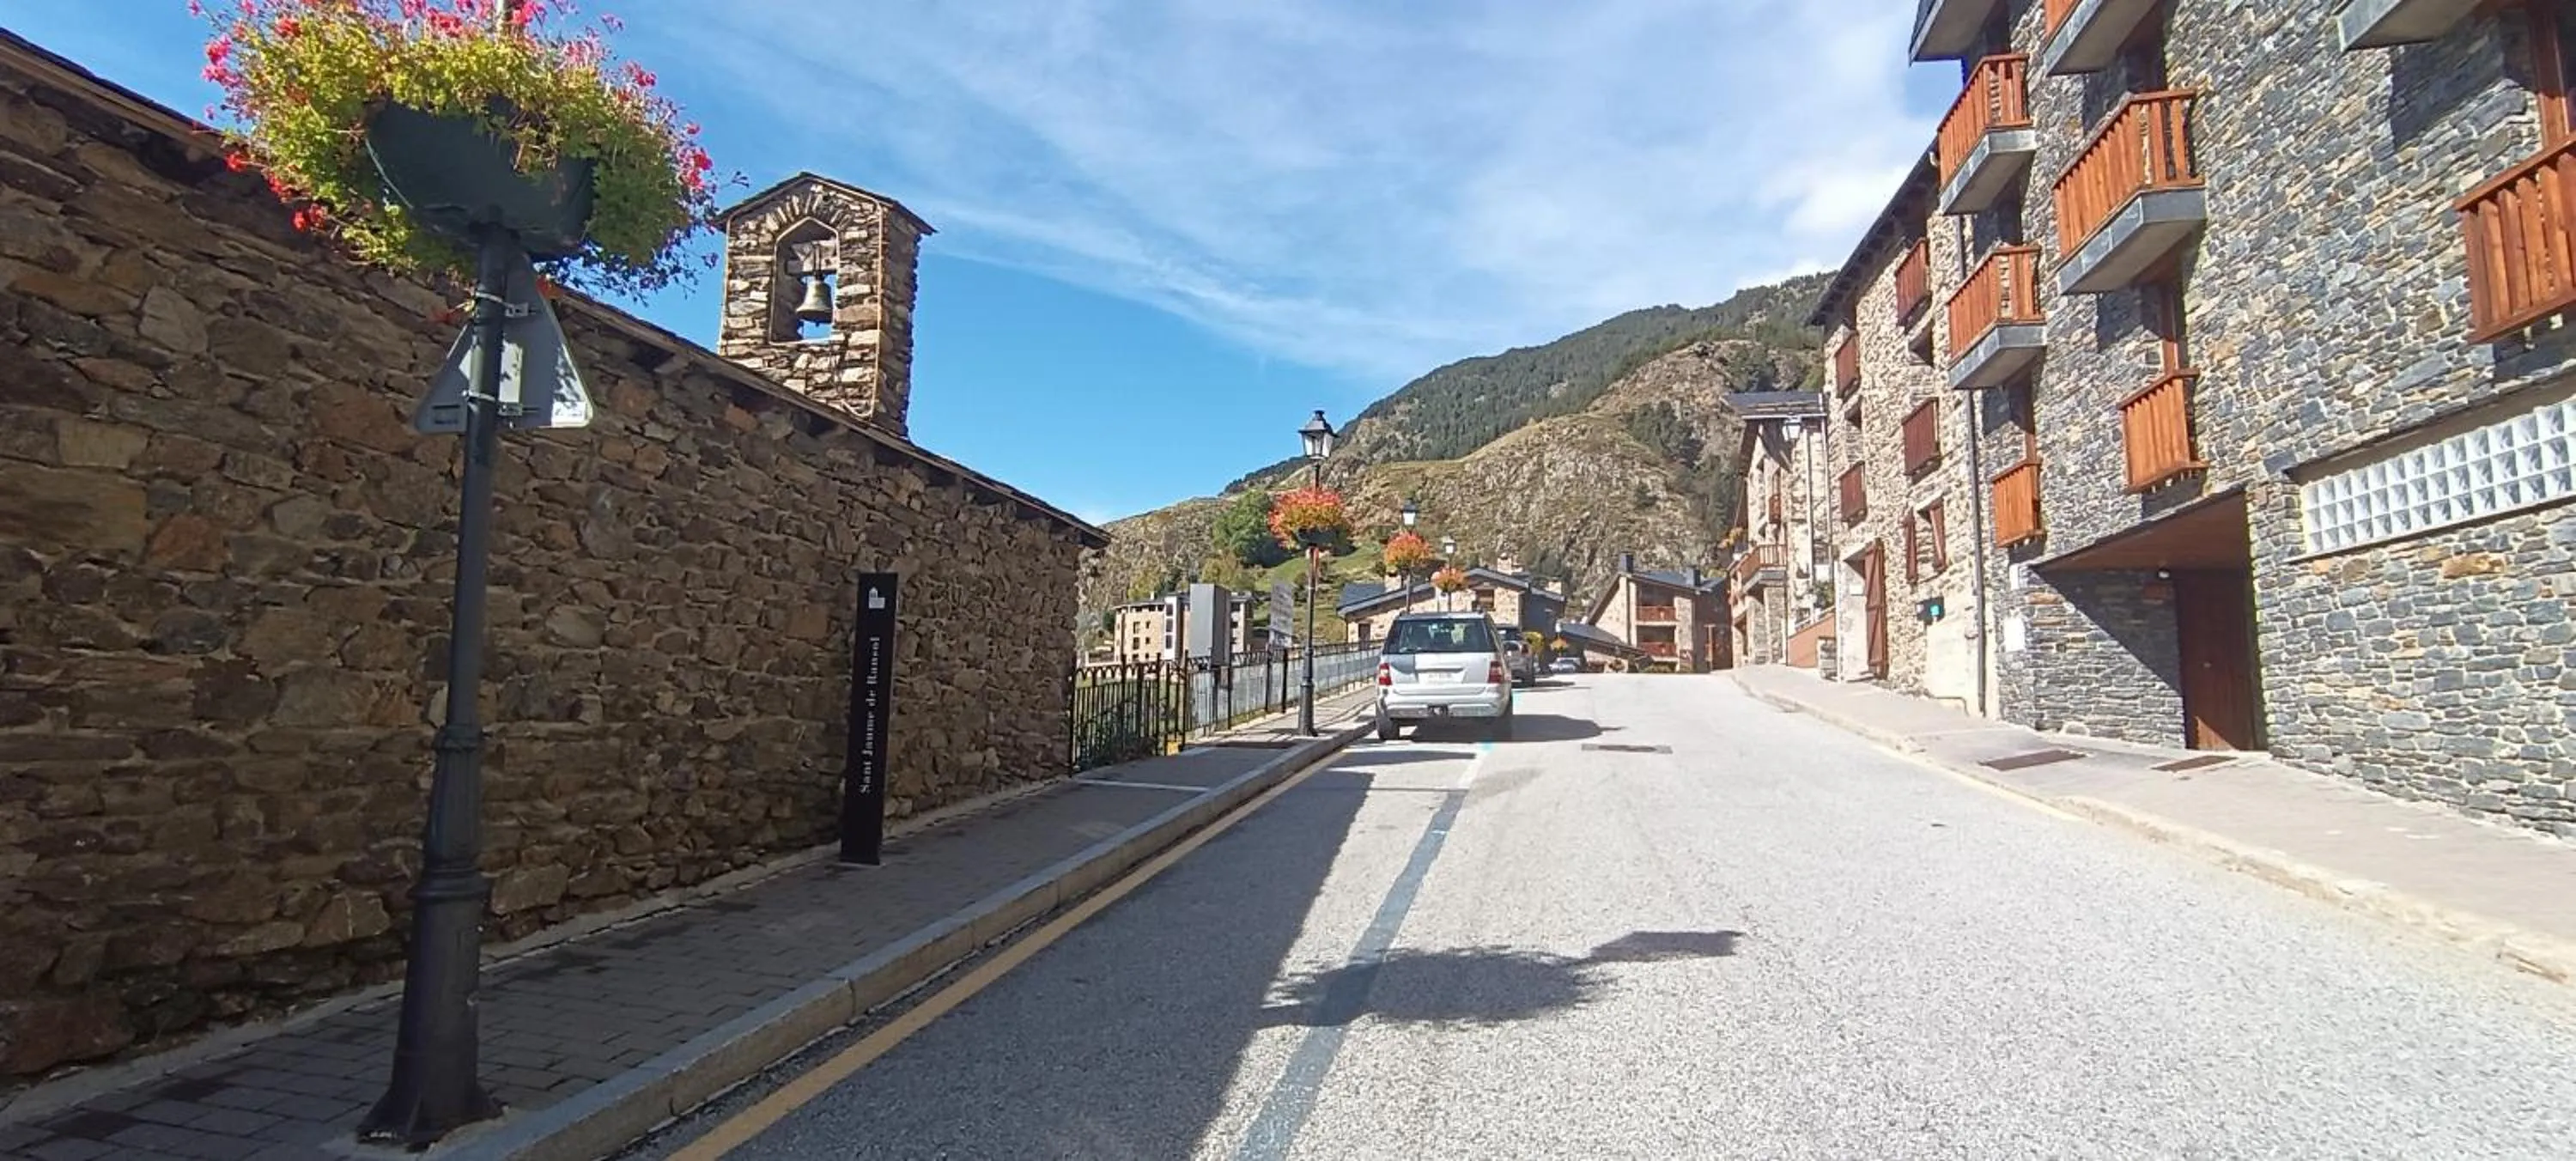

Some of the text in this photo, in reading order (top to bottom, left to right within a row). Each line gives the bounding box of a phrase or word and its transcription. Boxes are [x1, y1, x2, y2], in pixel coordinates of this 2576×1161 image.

[860, 636, 880, 793] Sant Jaume de Ransol
